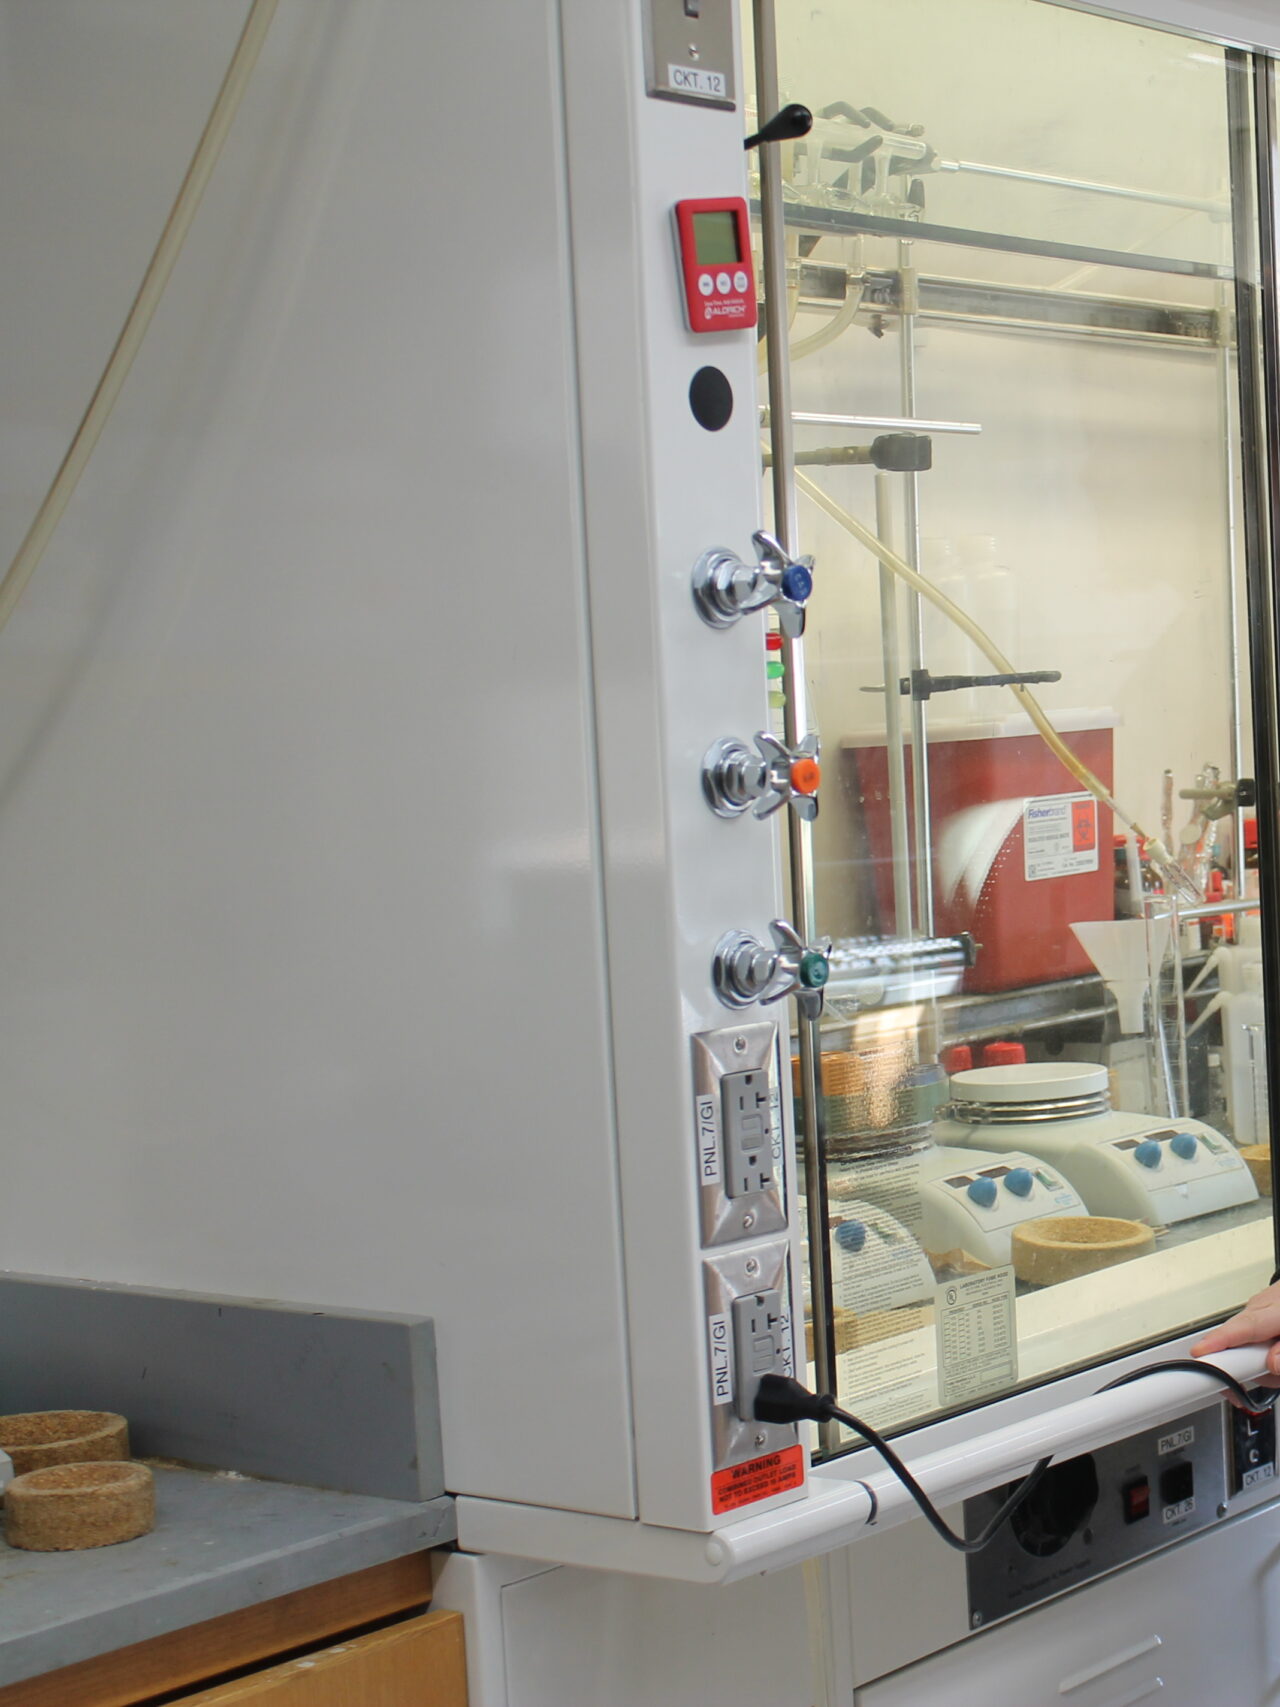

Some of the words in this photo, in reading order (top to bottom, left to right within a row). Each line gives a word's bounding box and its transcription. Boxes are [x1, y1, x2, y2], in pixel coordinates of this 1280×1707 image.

[673, 69, 704, 89] CKT.
[707, 75, 721, 92] 12
[700, 1101, 717, 1177] PNL.7/GI
[713, 1321, 729, 1397] PNL.7/GI
[731, 1455, 781, 1479] WARNING
[1263, 1466, 1272, 1477] 12
[719, 1493, 732, 1502] NOT
[734, 1489, 743, 1497] TO
[743, 1481, 768, 1494] EXCEED
